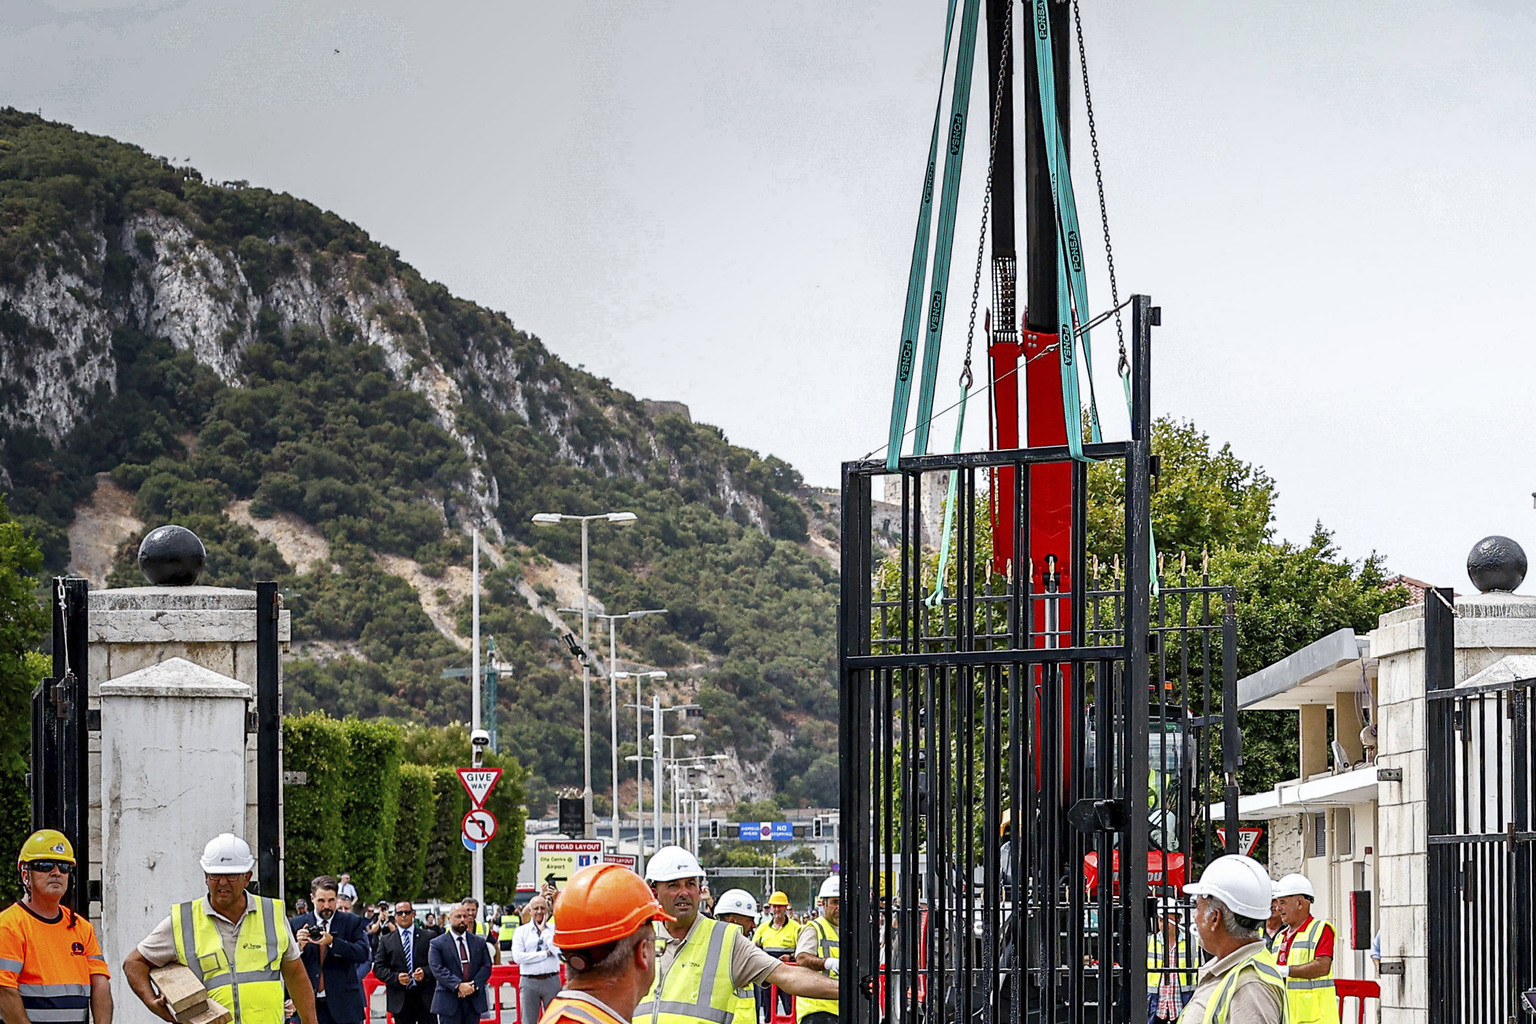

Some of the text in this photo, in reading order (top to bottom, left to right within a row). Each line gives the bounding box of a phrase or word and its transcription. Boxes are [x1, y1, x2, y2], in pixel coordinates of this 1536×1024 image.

[1037, 1, 1047, 38] PONSA
[952, 114, 963, 154] PONSA
[1068, 232, 1080, 270] PONSA
[931, 293, 941, 331] PONSA
[901, 341, 912, 380] PONSA
[1062, 325, 1072, 365] PONSA
[466, 773, 492, 782] GIVE
